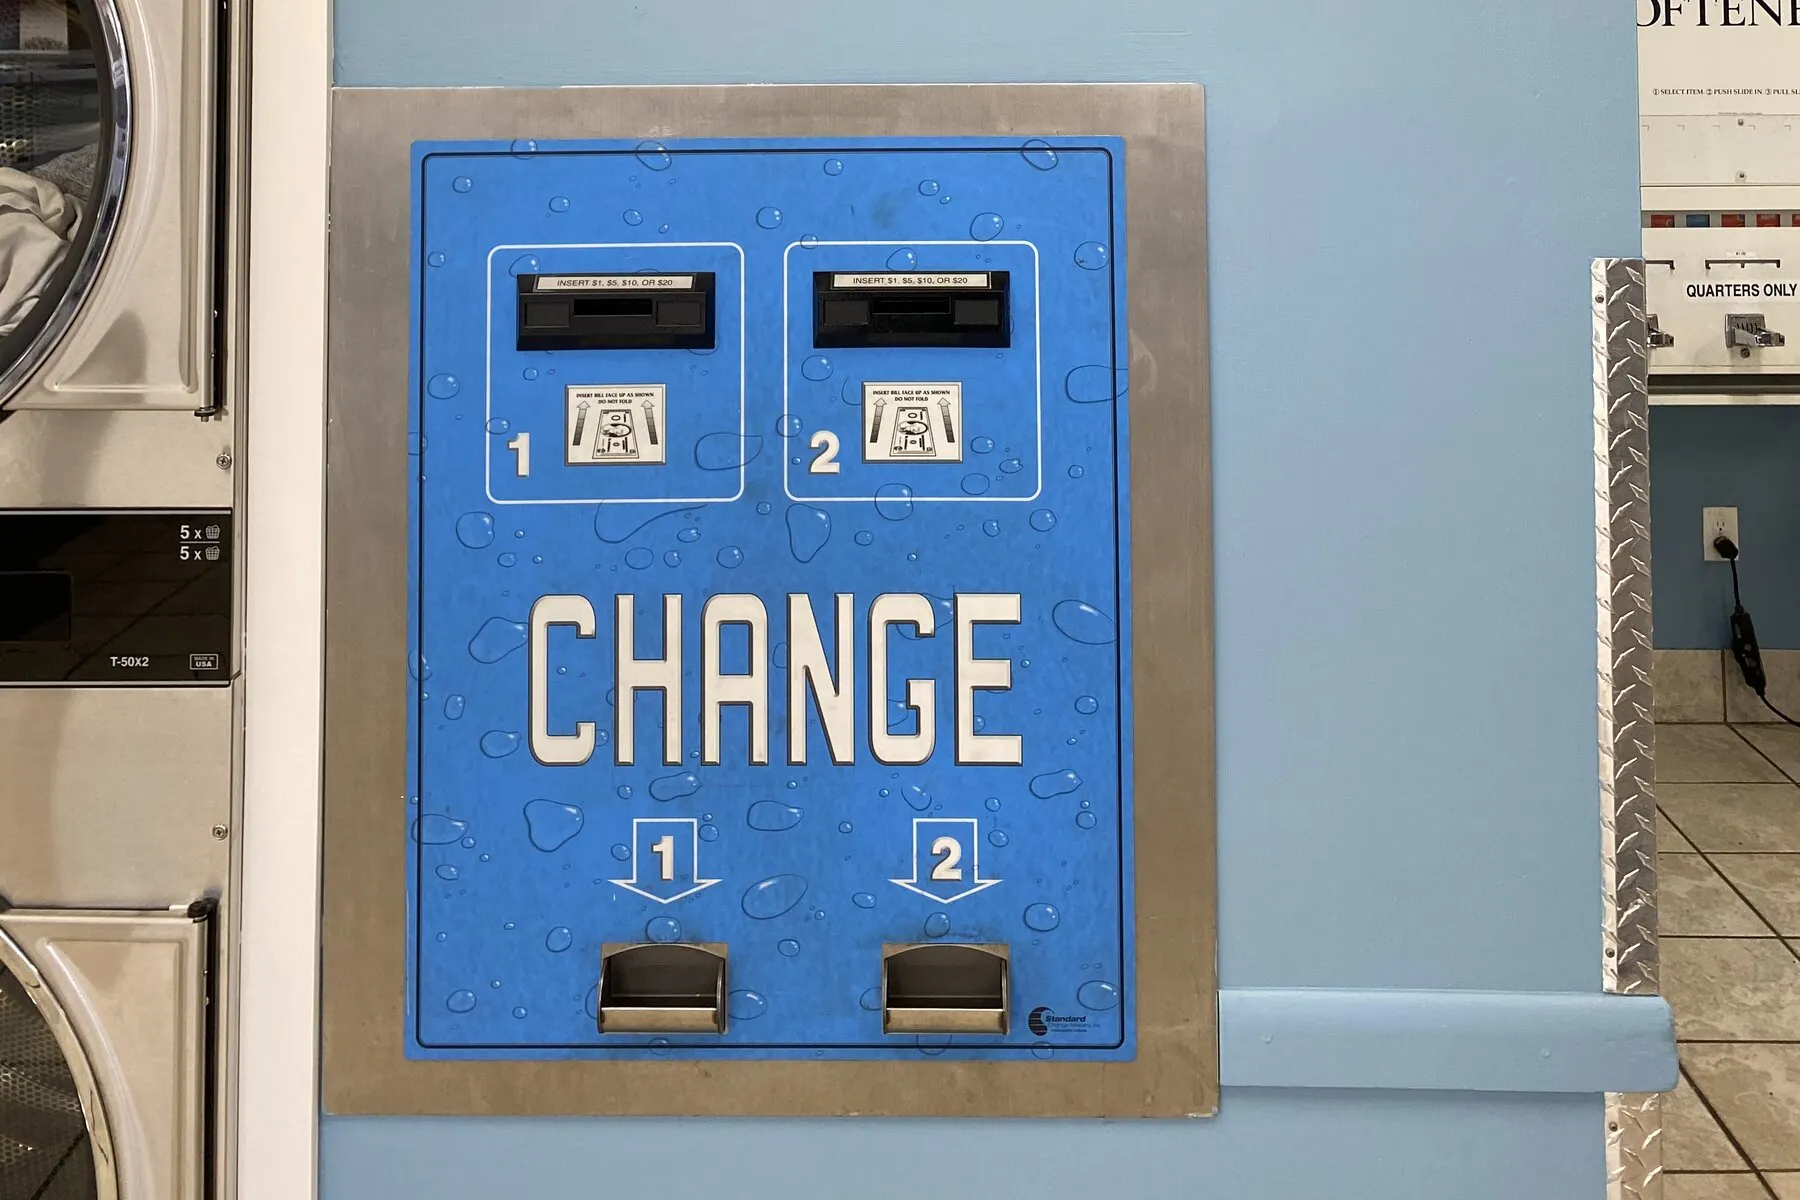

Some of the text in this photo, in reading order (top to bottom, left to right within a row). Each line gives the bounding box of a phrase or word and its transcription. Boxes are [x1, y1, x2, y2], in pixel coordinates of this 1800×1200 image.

[937, 276, 950, 284] OR
[952, 276, 968, 284] $20
[1687, 283, 1798, 298] QUARTERS ONLY
[508, 432, 531, 477] 1
[809, 430, 841, 474] 2
[180, 524, 190, 540] 5
[180, 545, 190, 561] 5
[110, 656, 150, 667] T-50X2
[528, 592, 1024, 767] CHANGE
[650, 835, 675, 882] 1
[930, 836, 963, 881] 2
[1045, 1015, 1087, 1023] Standard
